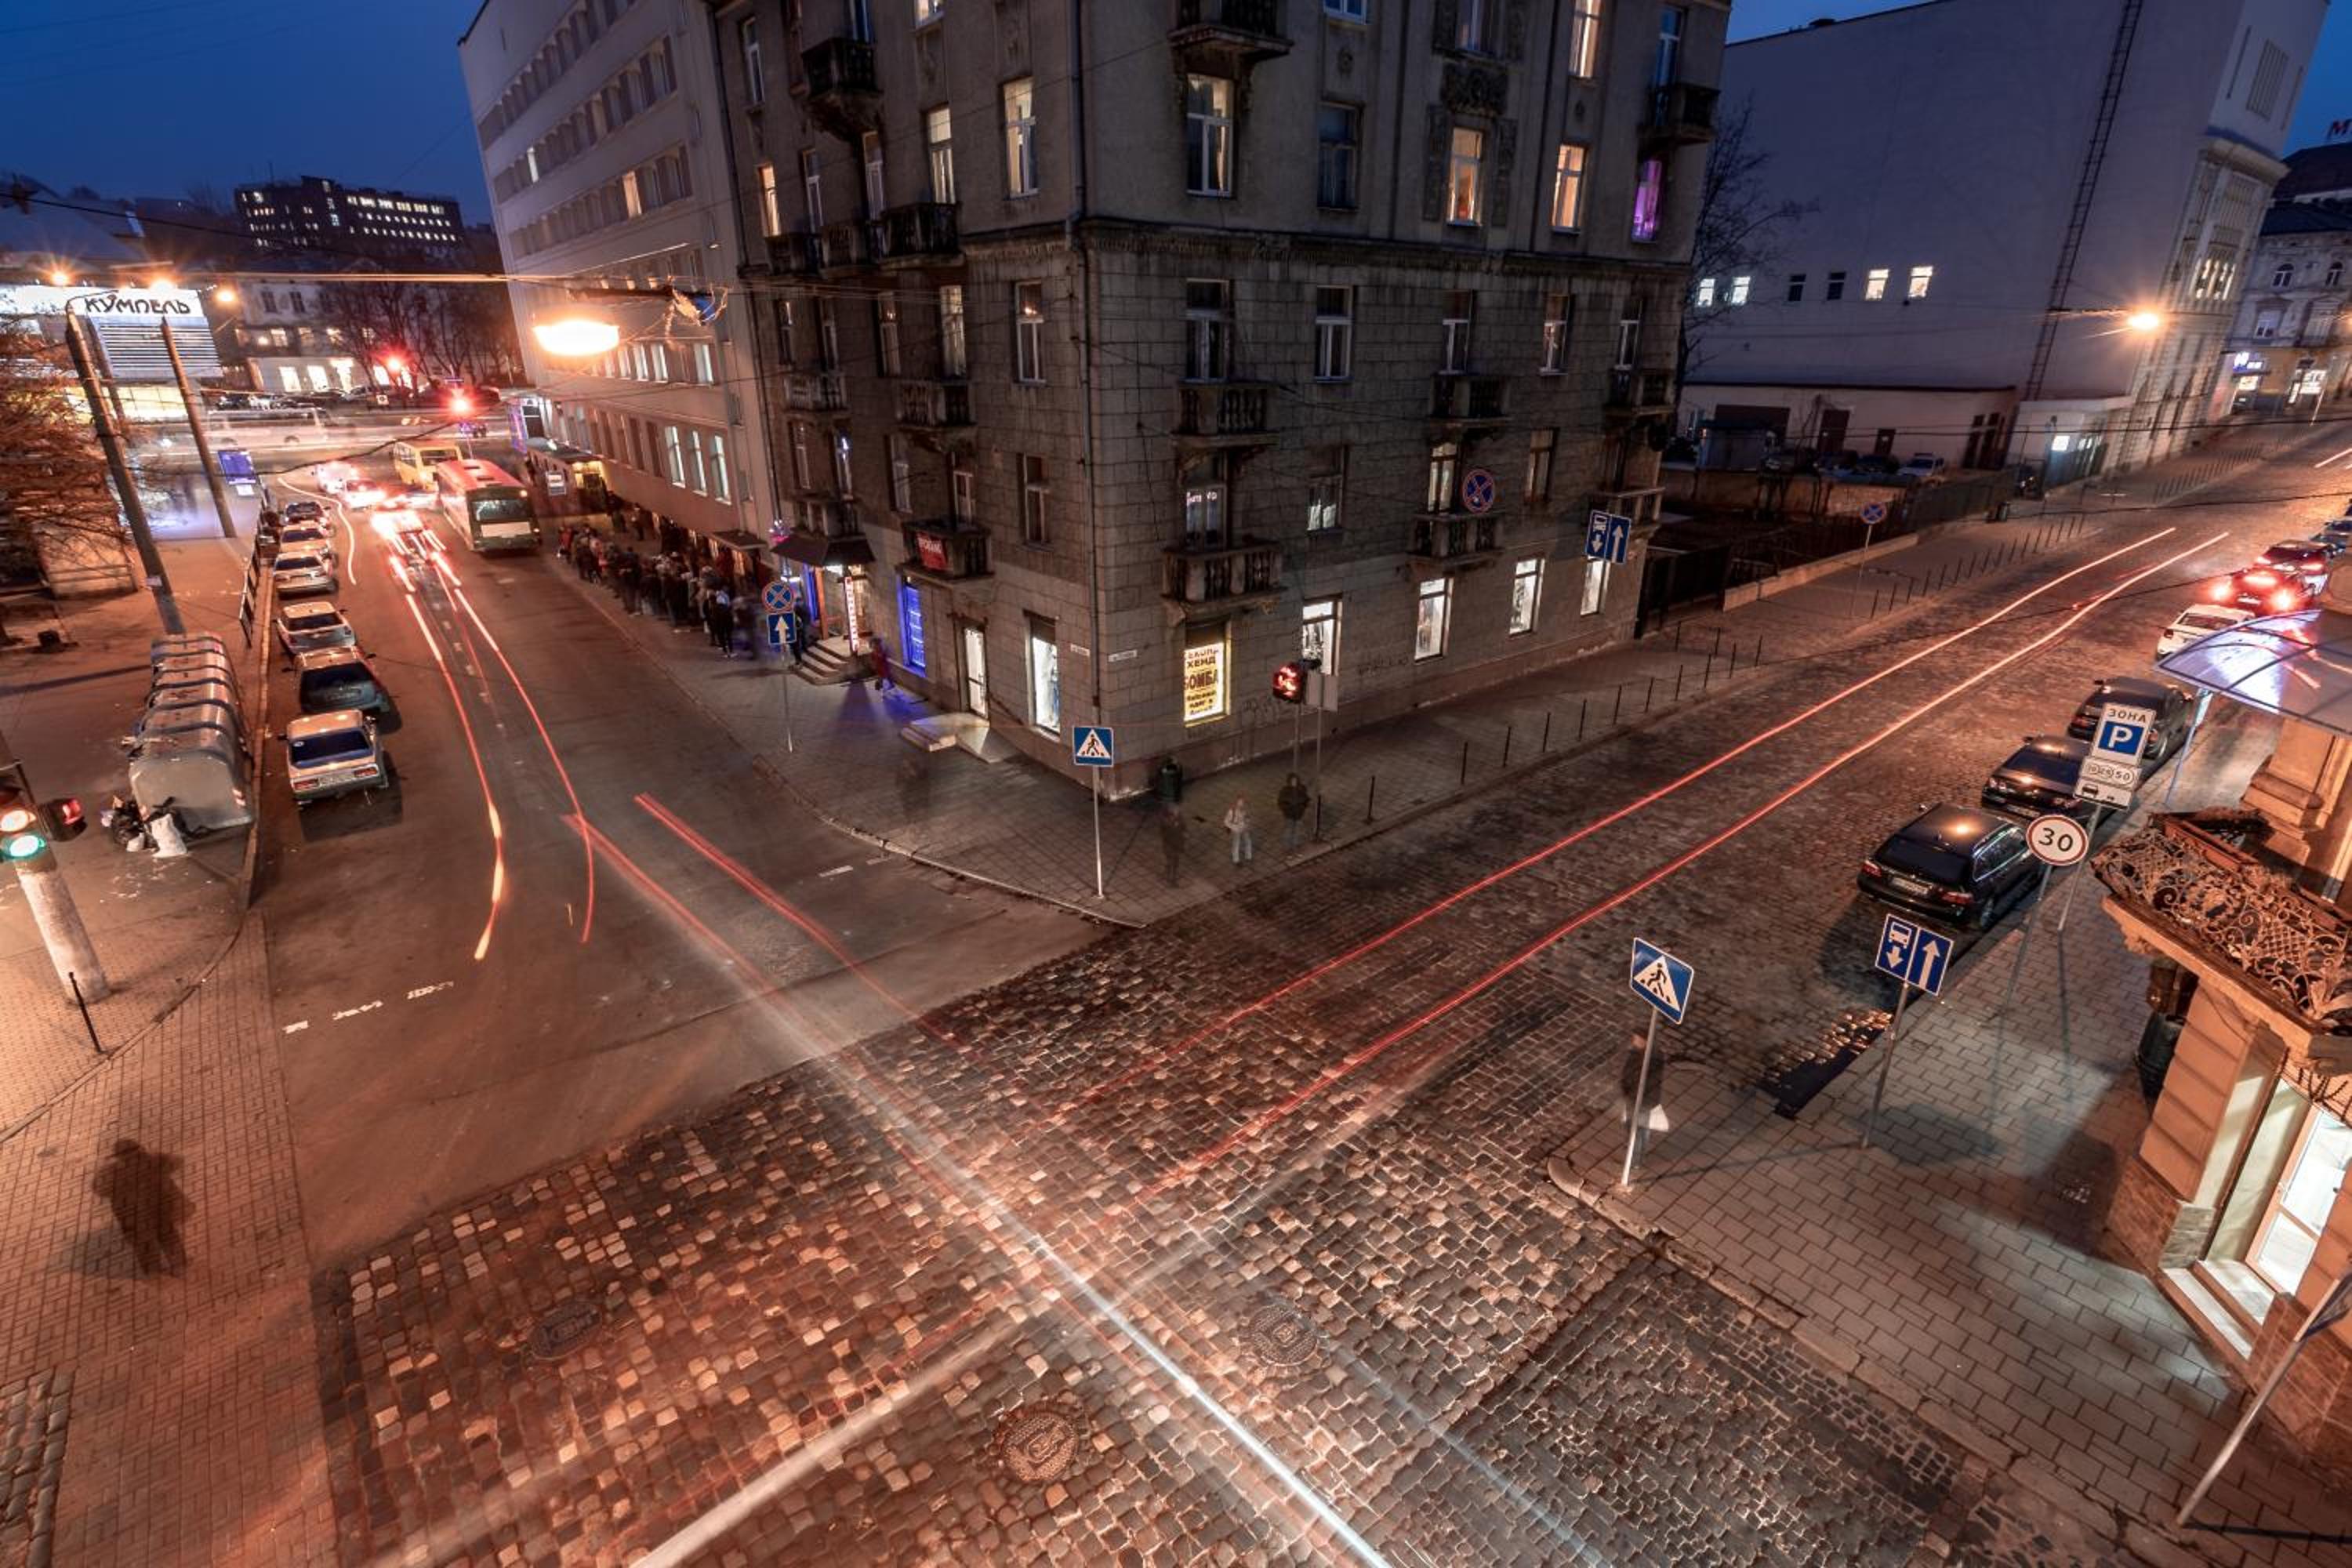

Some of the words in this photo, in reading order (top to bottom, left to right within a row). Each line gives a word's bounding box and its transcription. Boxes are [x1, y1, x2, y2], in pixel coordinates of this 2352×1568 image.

[84, 294, 191, 314] КУМПЕЛЬ
[1187, 656, 1215, 667] ХЕНД
[2107, 708, 2147, 723] ЗОНА
[2107, 726, 2133, 749] P
[2115, 771, 2130, 782] 50
[2038, 827, 2074, 852] 30
